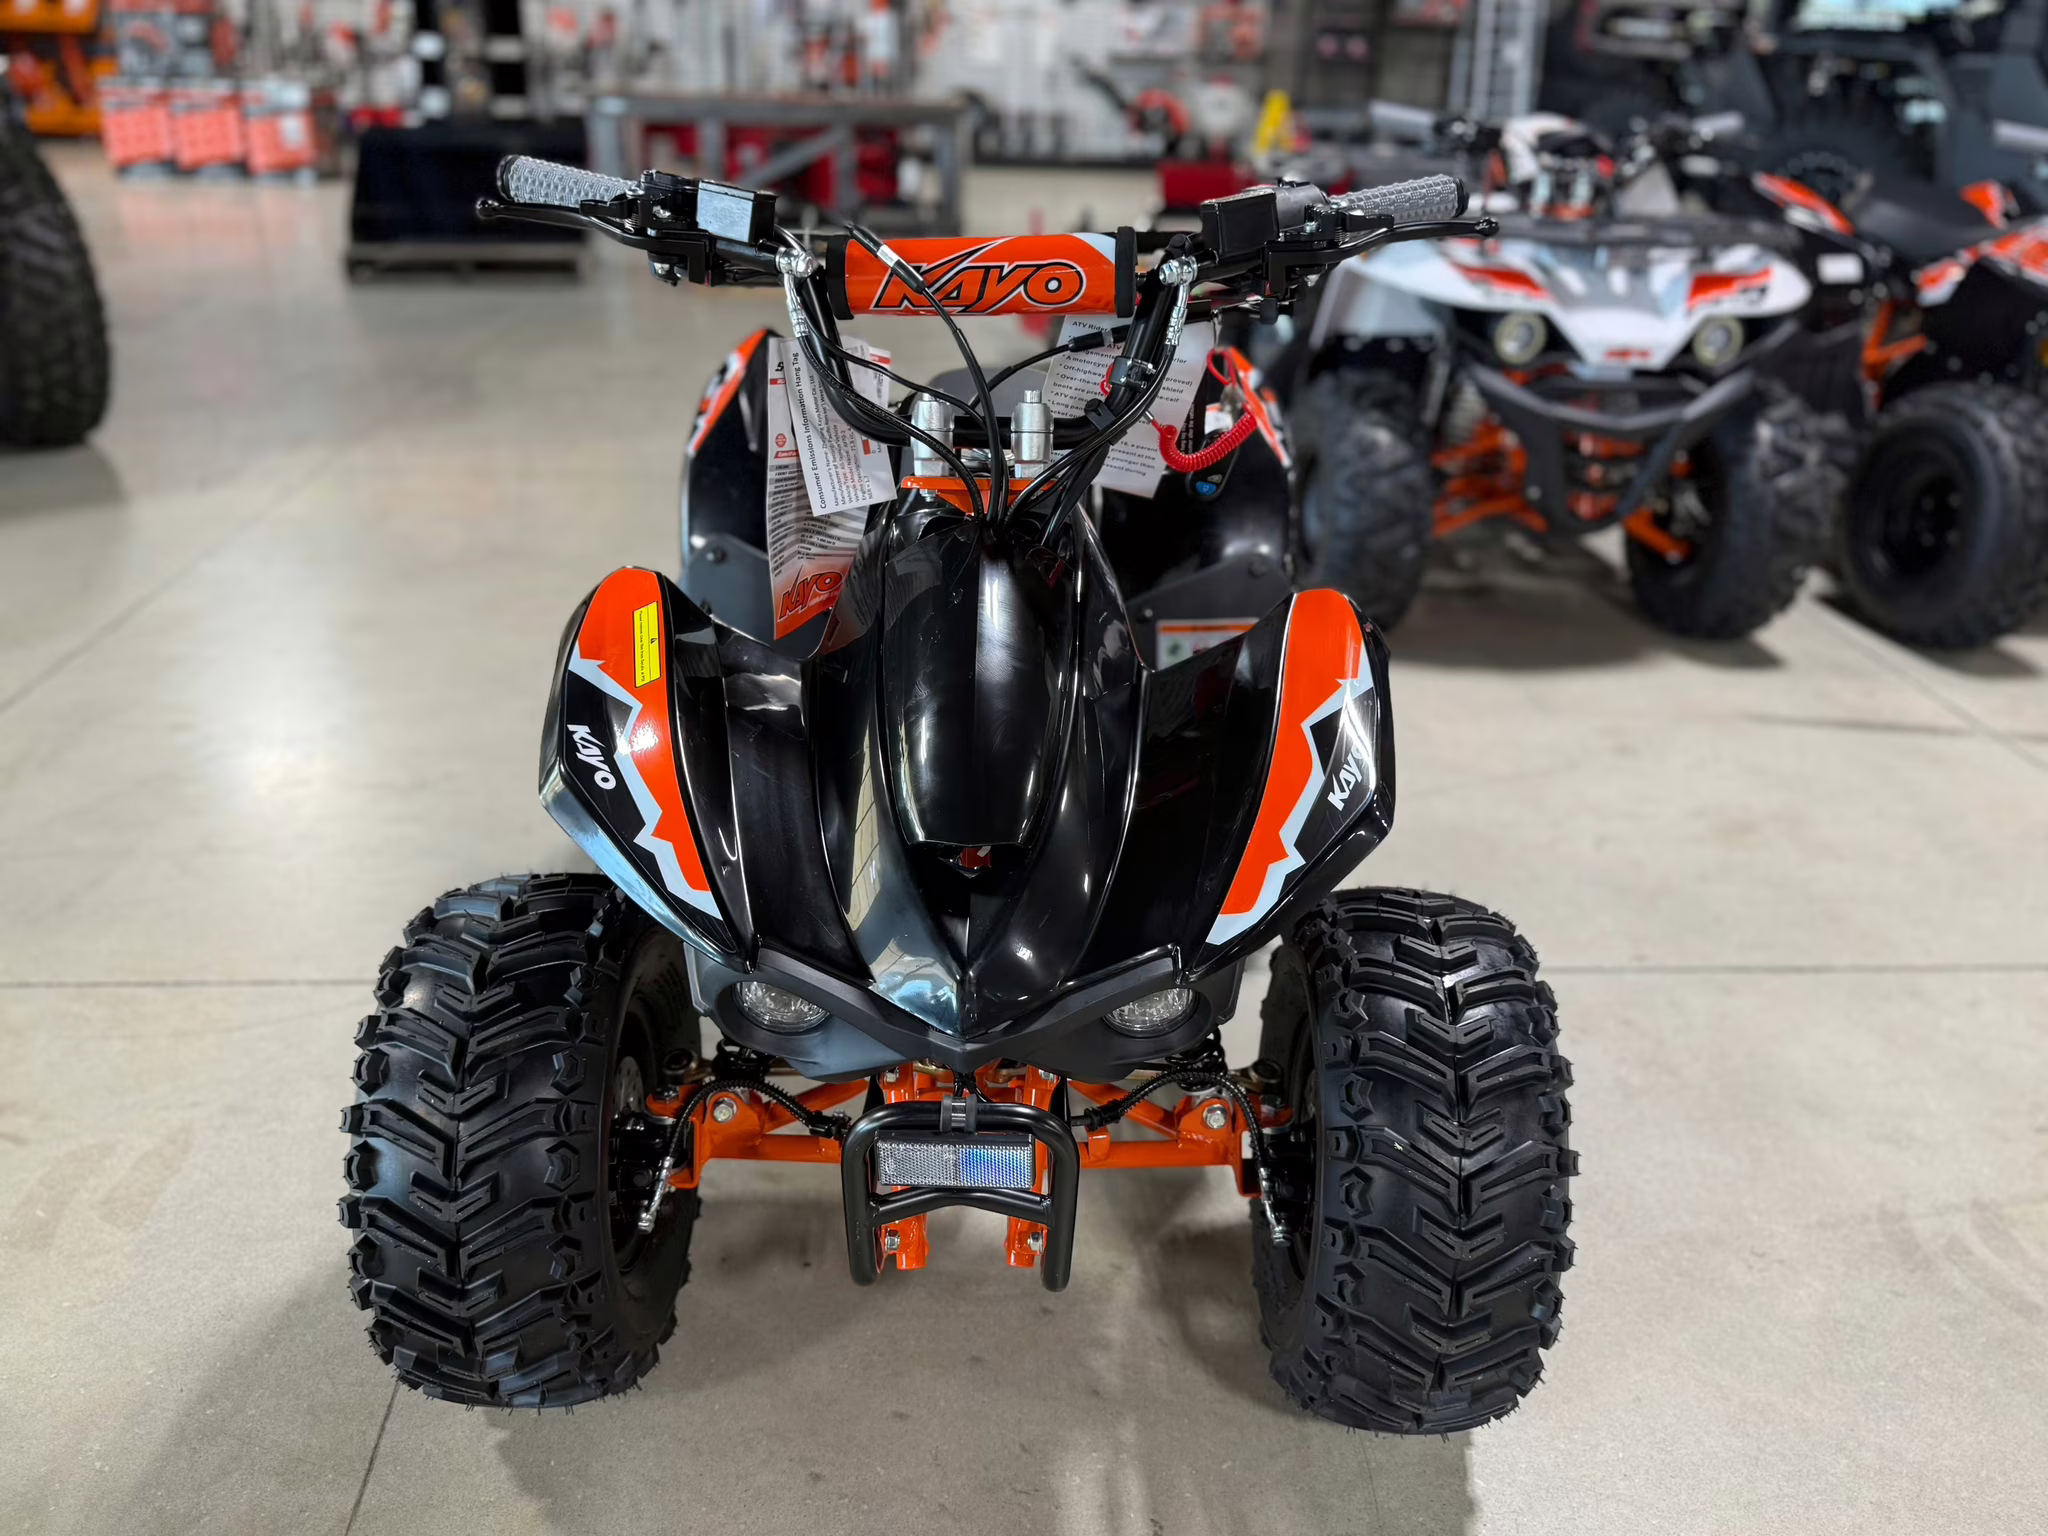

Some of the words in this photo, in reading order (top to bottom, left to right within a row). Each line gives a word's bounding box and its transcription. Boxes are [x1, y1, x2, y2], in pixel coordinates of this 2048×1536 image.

[871, 237, 1086, 313] KAYO
[1088, 324, 1108, 332] Rider
[1106, 343, 1122, 351] ATV
[792, 352, 800, 366] Tag
[1072, 357, 1110, 368] motorcycl
[794, 366, 803, 387] Hang
[1052, 381, 1073, 390] boots
[1053, 391, 1069, 399] ATV
[797, 388, 810, 433] Information
[1051, 400, 1070, 409] Long
[806, 434, 817, 471] Emissions
[1111, 456, 1139, 466] younger
[813, 472, 826, 509] Consumer
[777, 563, 842, 622] KAYO
[567, 724, 616, 790] KAYO
